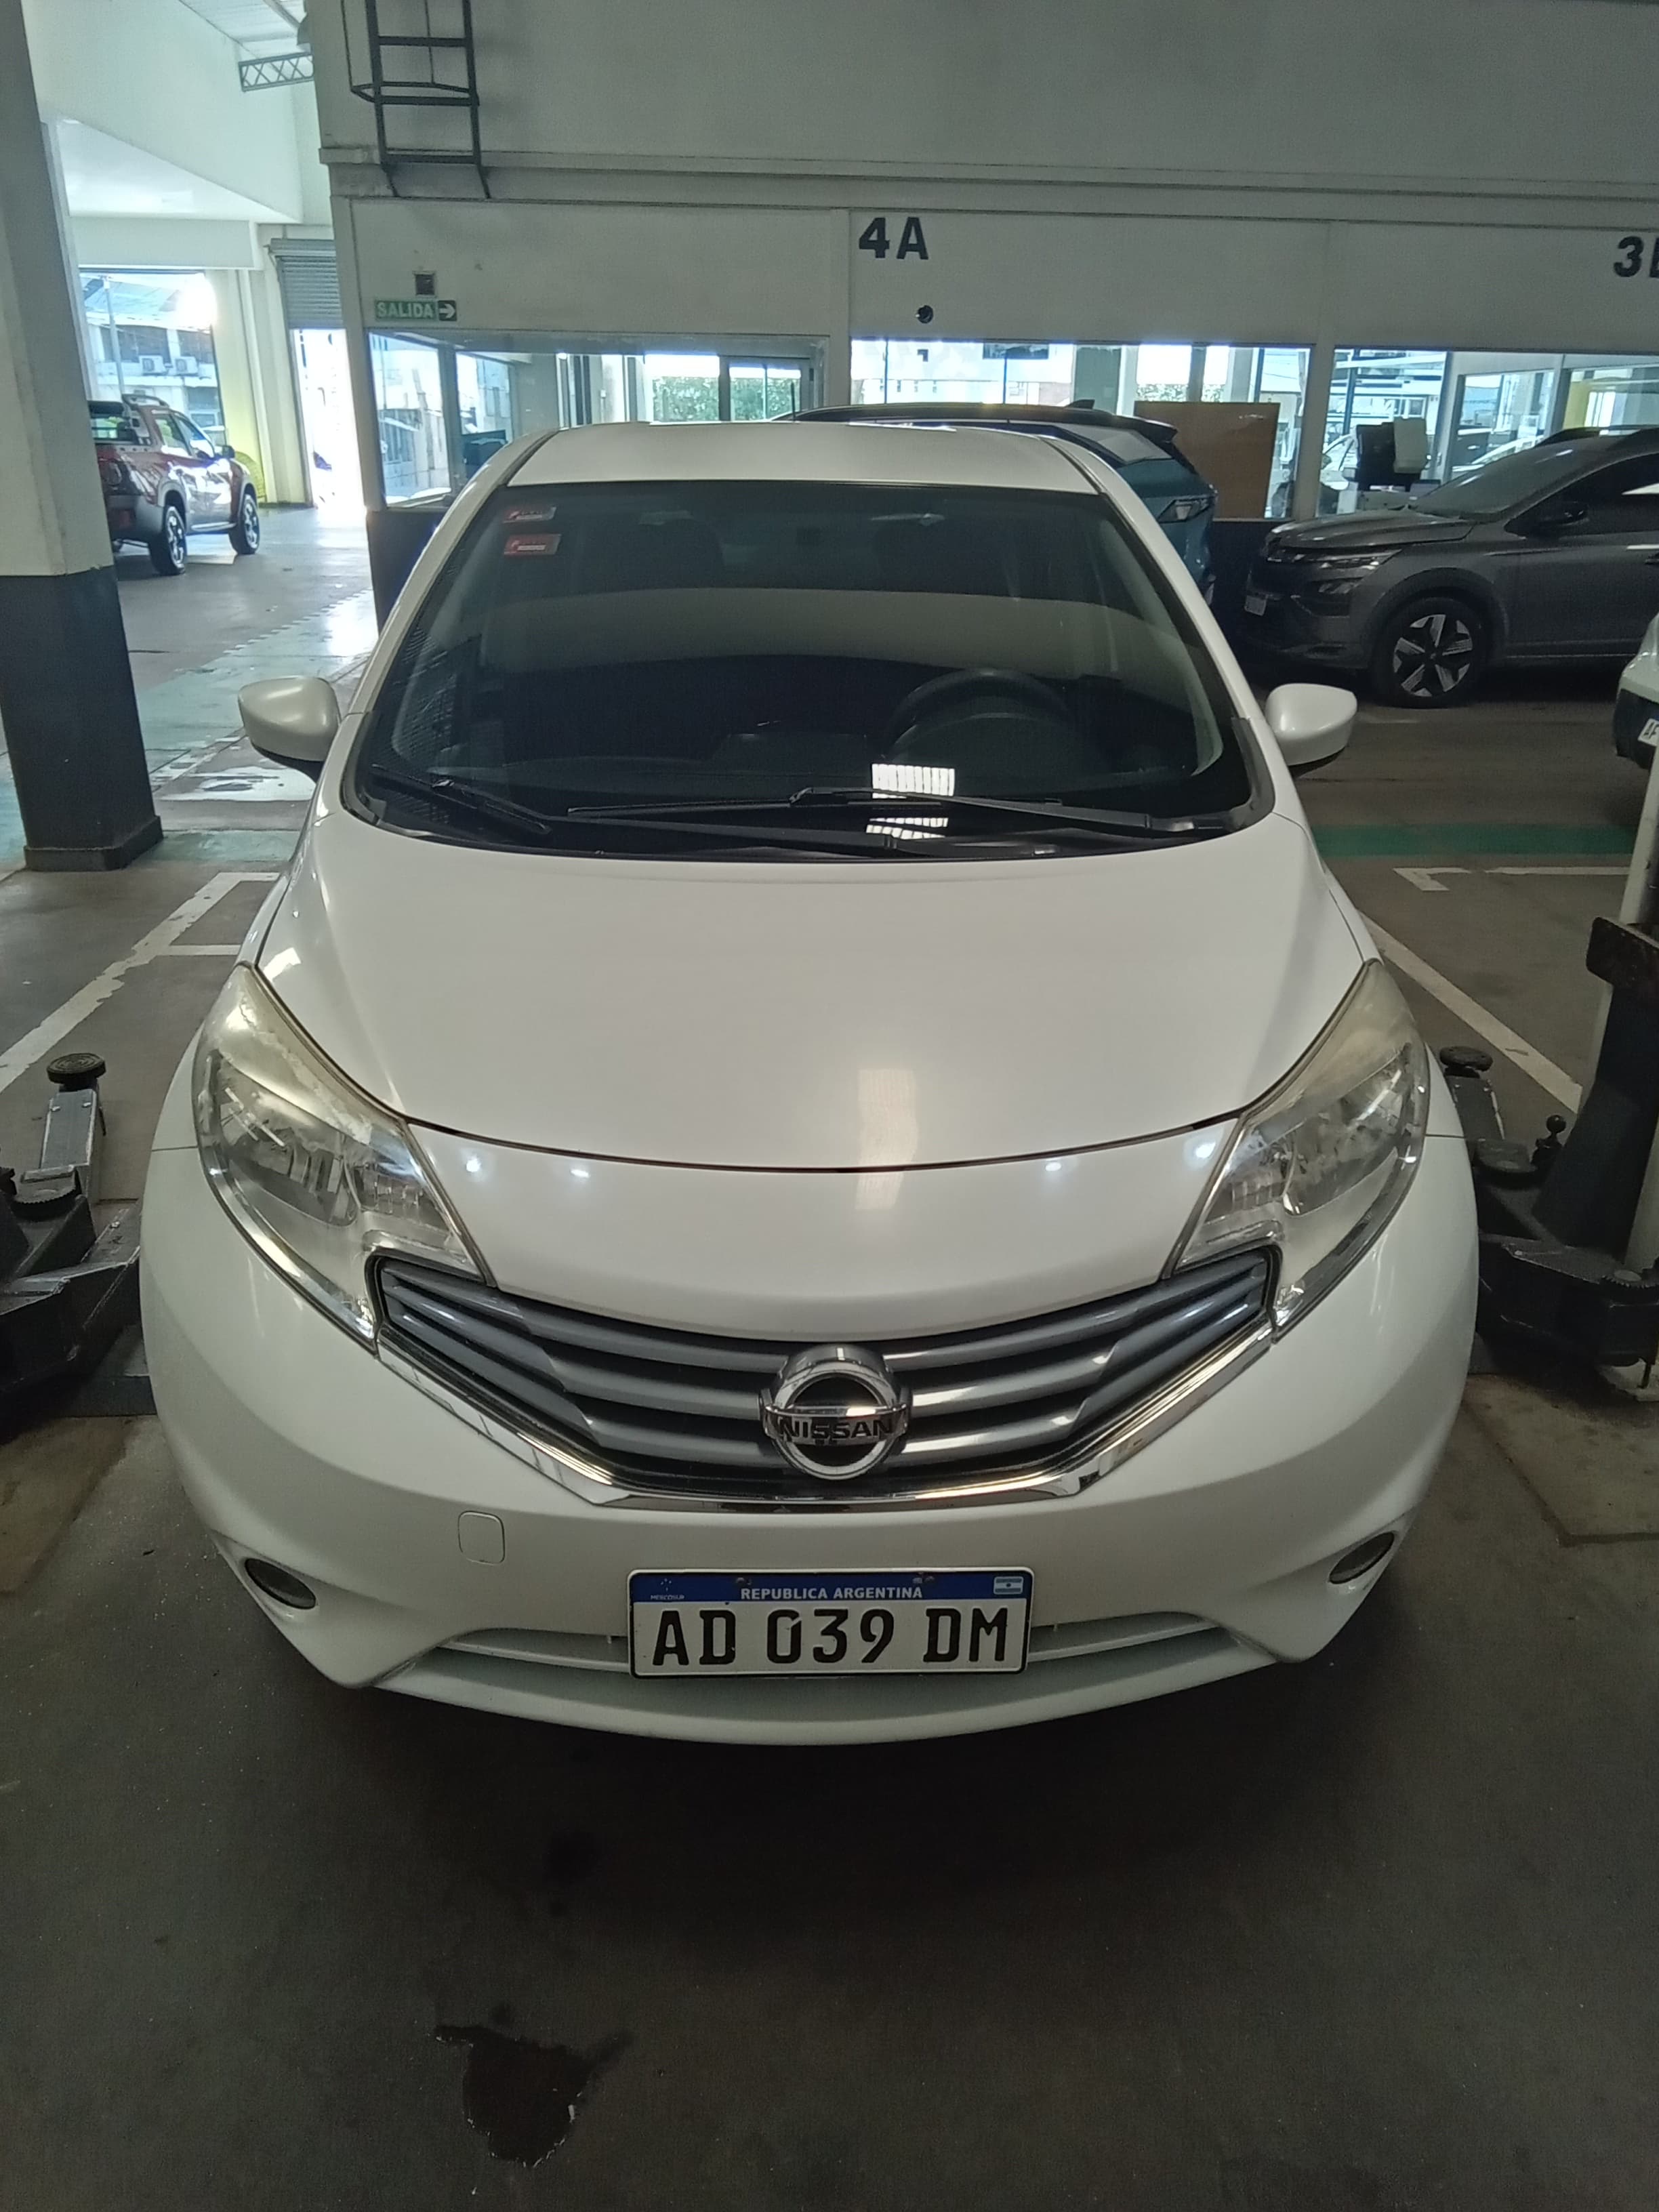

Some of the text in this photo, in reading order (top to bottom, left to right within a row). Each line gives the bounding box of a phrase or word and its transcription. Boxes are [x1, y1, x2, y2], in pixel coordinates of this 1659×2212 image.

[859, 217, 928, 260] 4A
[377, 302, 434, 318] SALIDA
[779, 1415, 893, 1441] NISSAN
[741, 1586, 922, 1600] REPUBLICA ARGENTINA
[652, 1607, 1008, 1666] AD 039 DM
